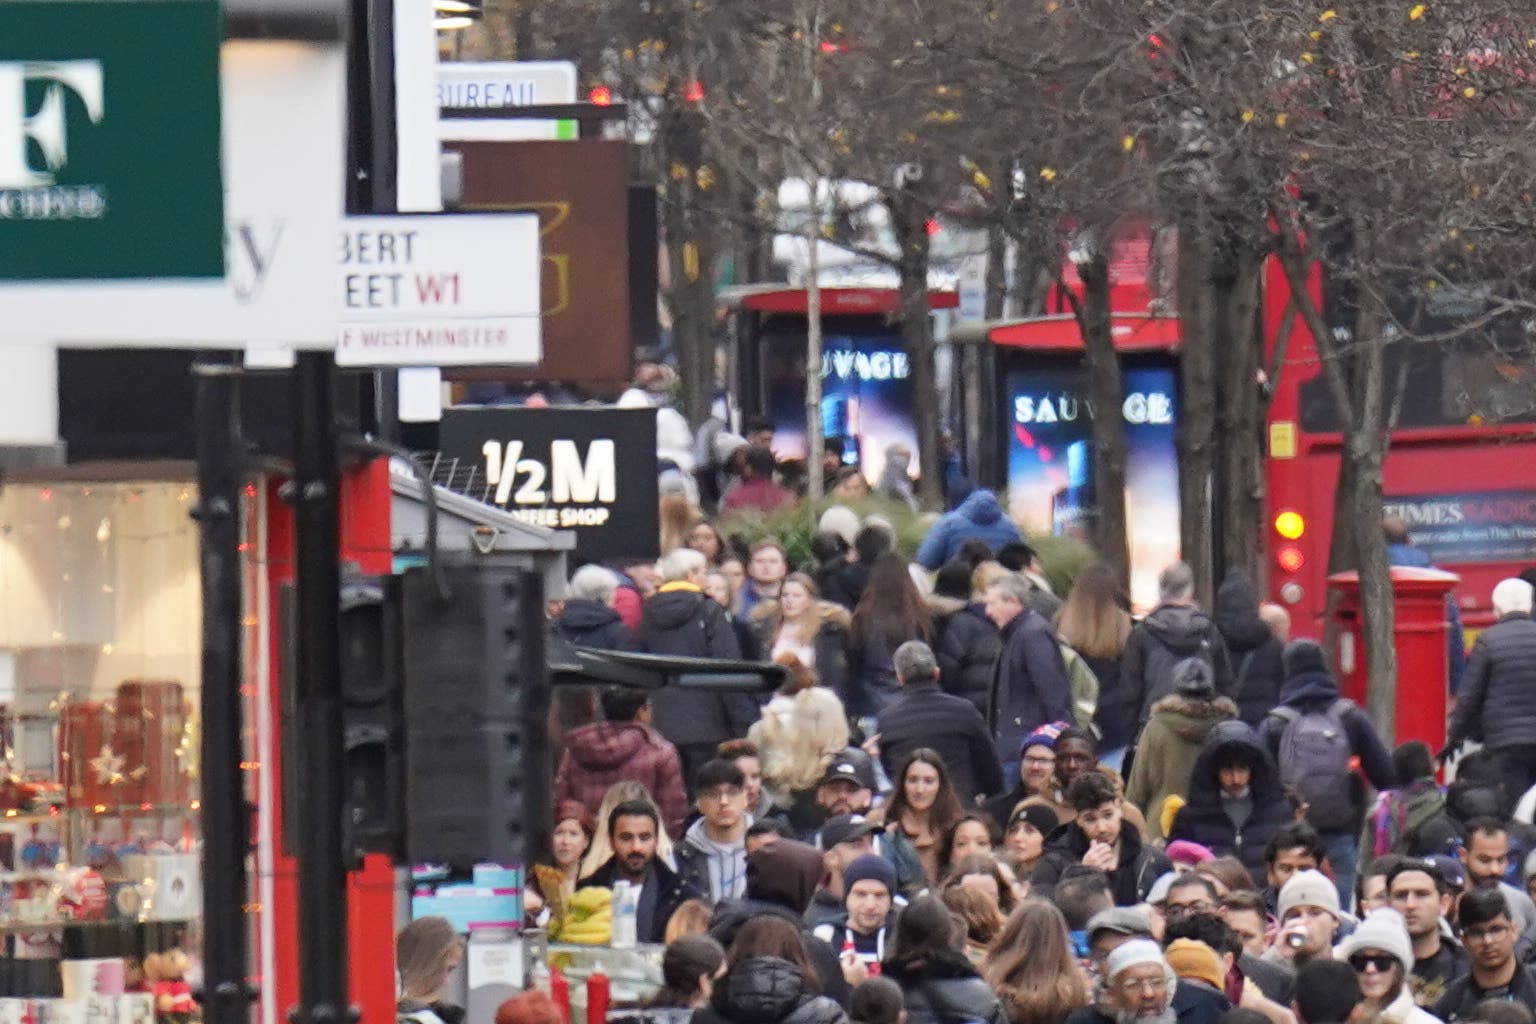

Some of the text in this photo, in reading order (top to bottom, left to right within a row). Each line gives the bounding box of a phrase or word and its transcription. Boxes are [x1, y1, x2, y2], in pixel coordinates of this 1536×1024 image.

[414, 272, 461, 304] W1
[361, 326, 509, 348] WESTMINSTER
[1014, 391, 1173, 425] SAUGE
[560, 507, 610, 527] SHOP
